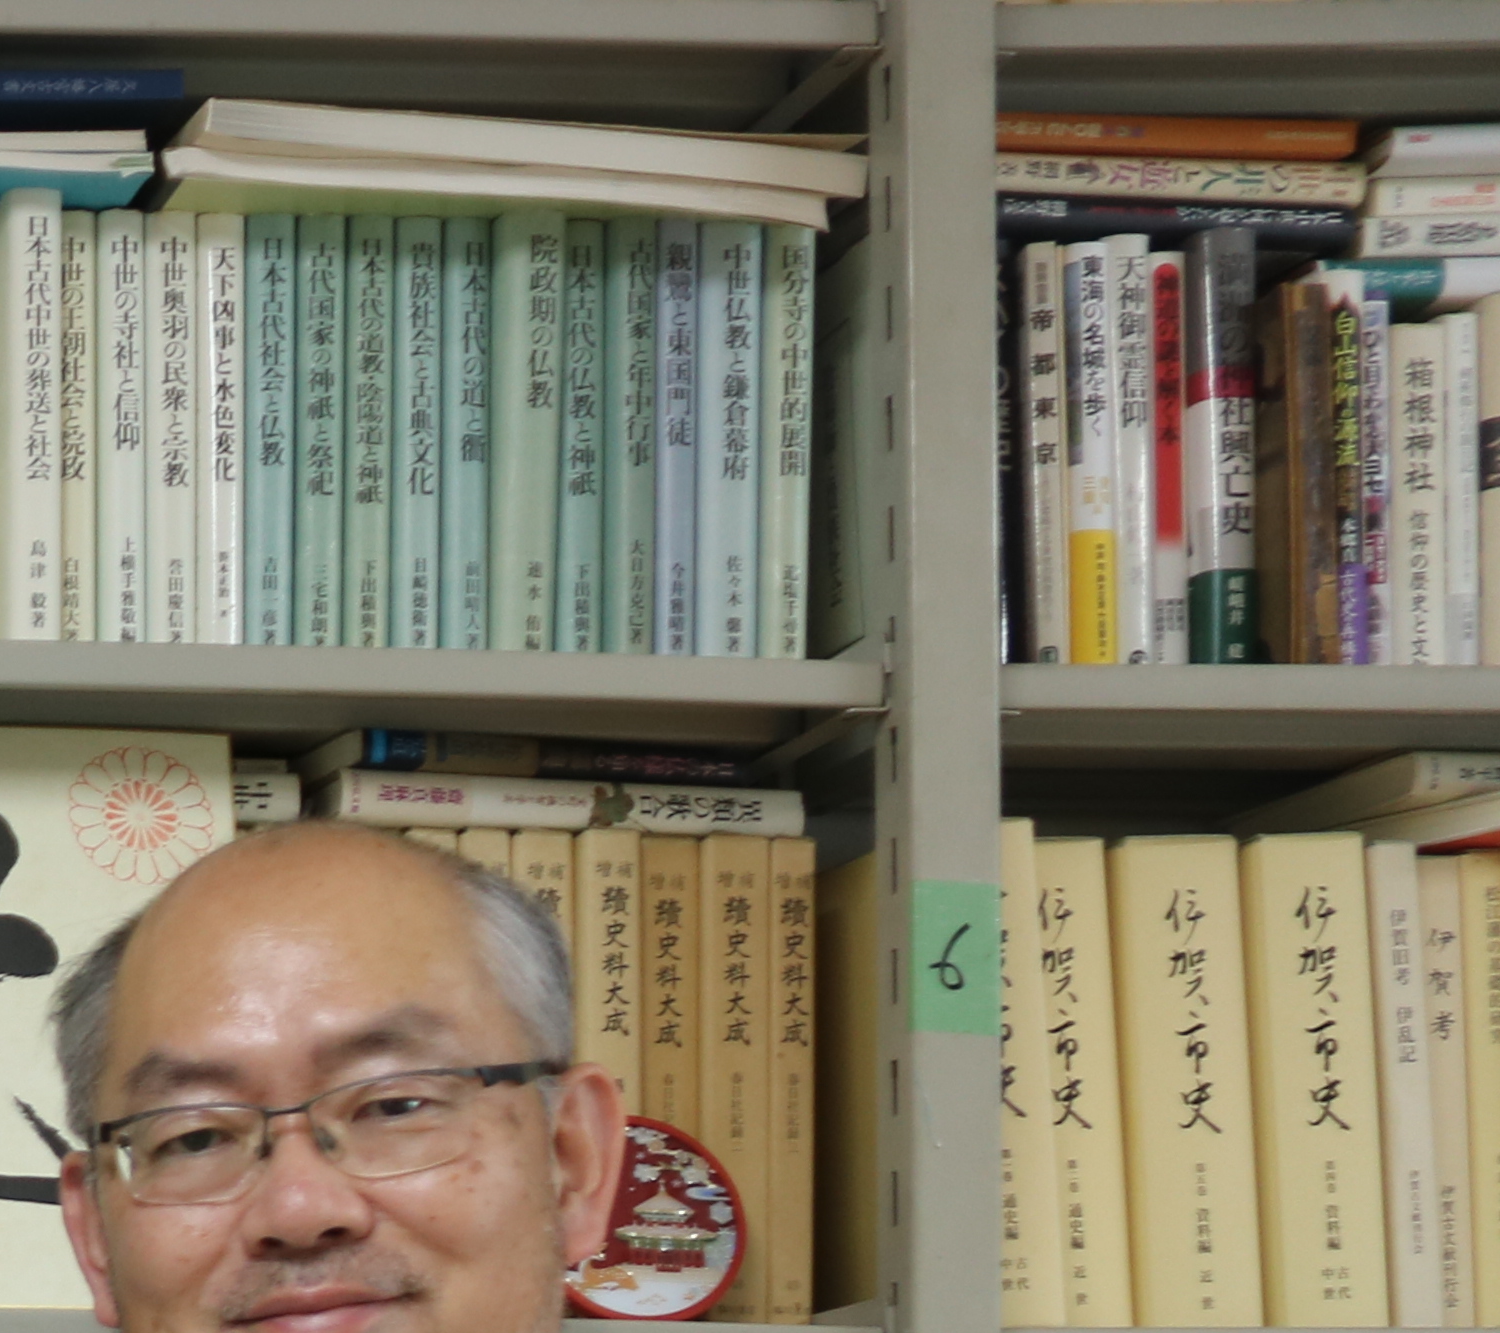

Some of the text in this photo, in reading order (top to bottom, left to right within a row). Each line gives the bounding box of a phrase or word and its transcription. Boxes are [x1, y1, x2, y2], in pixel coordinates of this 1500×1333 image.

[109, 234, 140, 451] 中世の寺社と信仰
[526, 234, 559, 409] 院政期の仏教
[929, 923, 972, 992] 6
